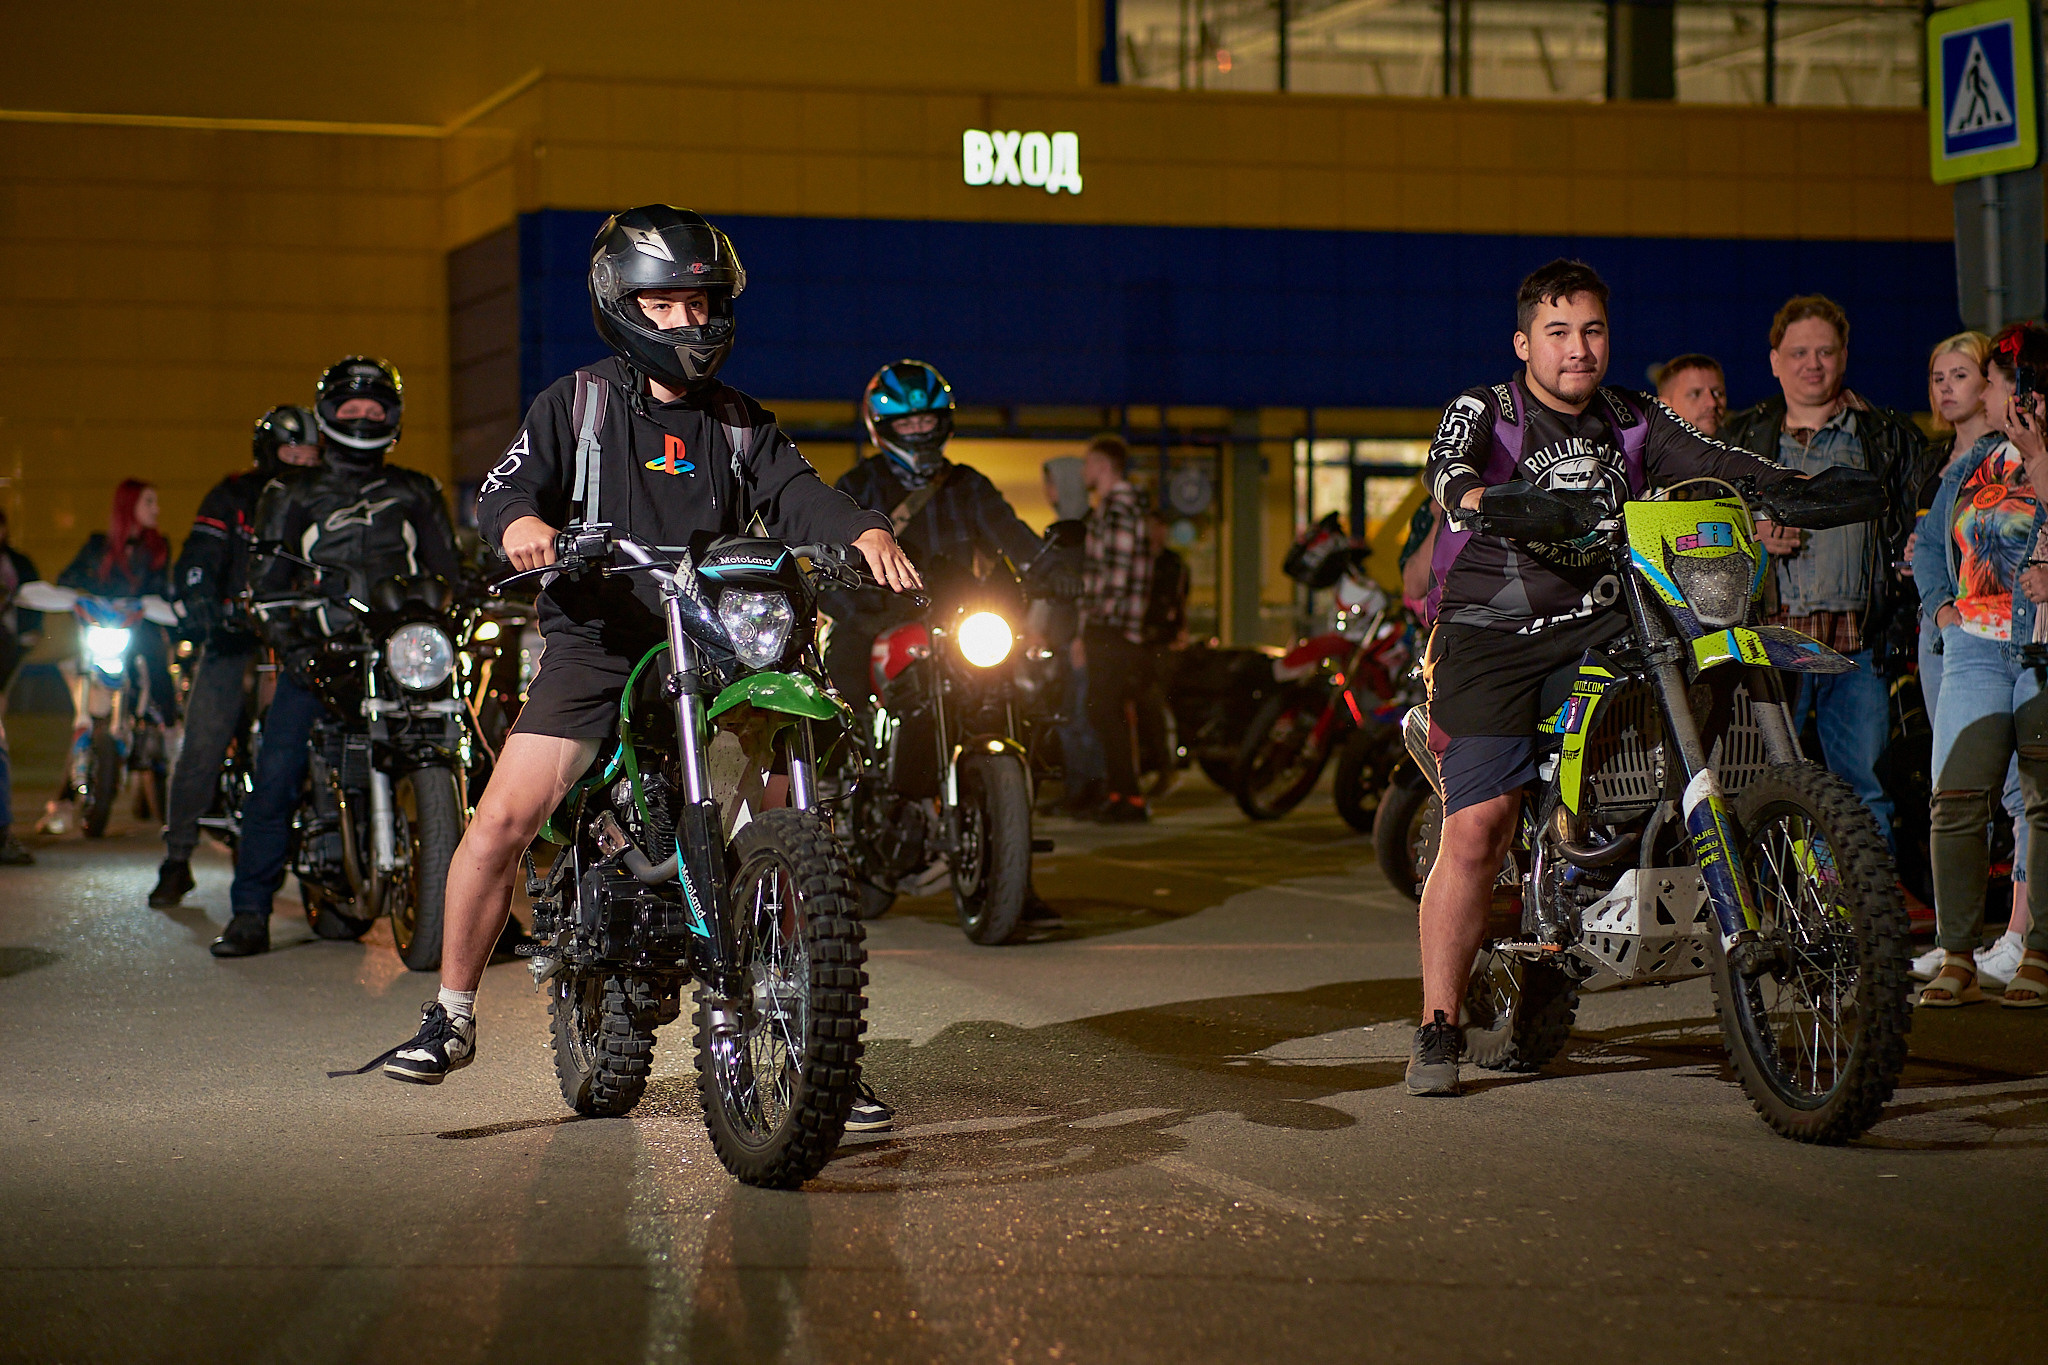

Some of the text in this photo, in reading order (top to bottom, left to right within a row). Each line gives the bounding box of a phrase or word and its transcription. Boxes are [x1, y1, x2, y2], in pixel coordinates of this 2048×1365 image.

[963, 129, 1083, 195] ВХОД
[1524, 437, 1594, 475] ROLLING
[719, 556, 772, 566] MotoLand
[681, 863, 707, 919] MotoLand
